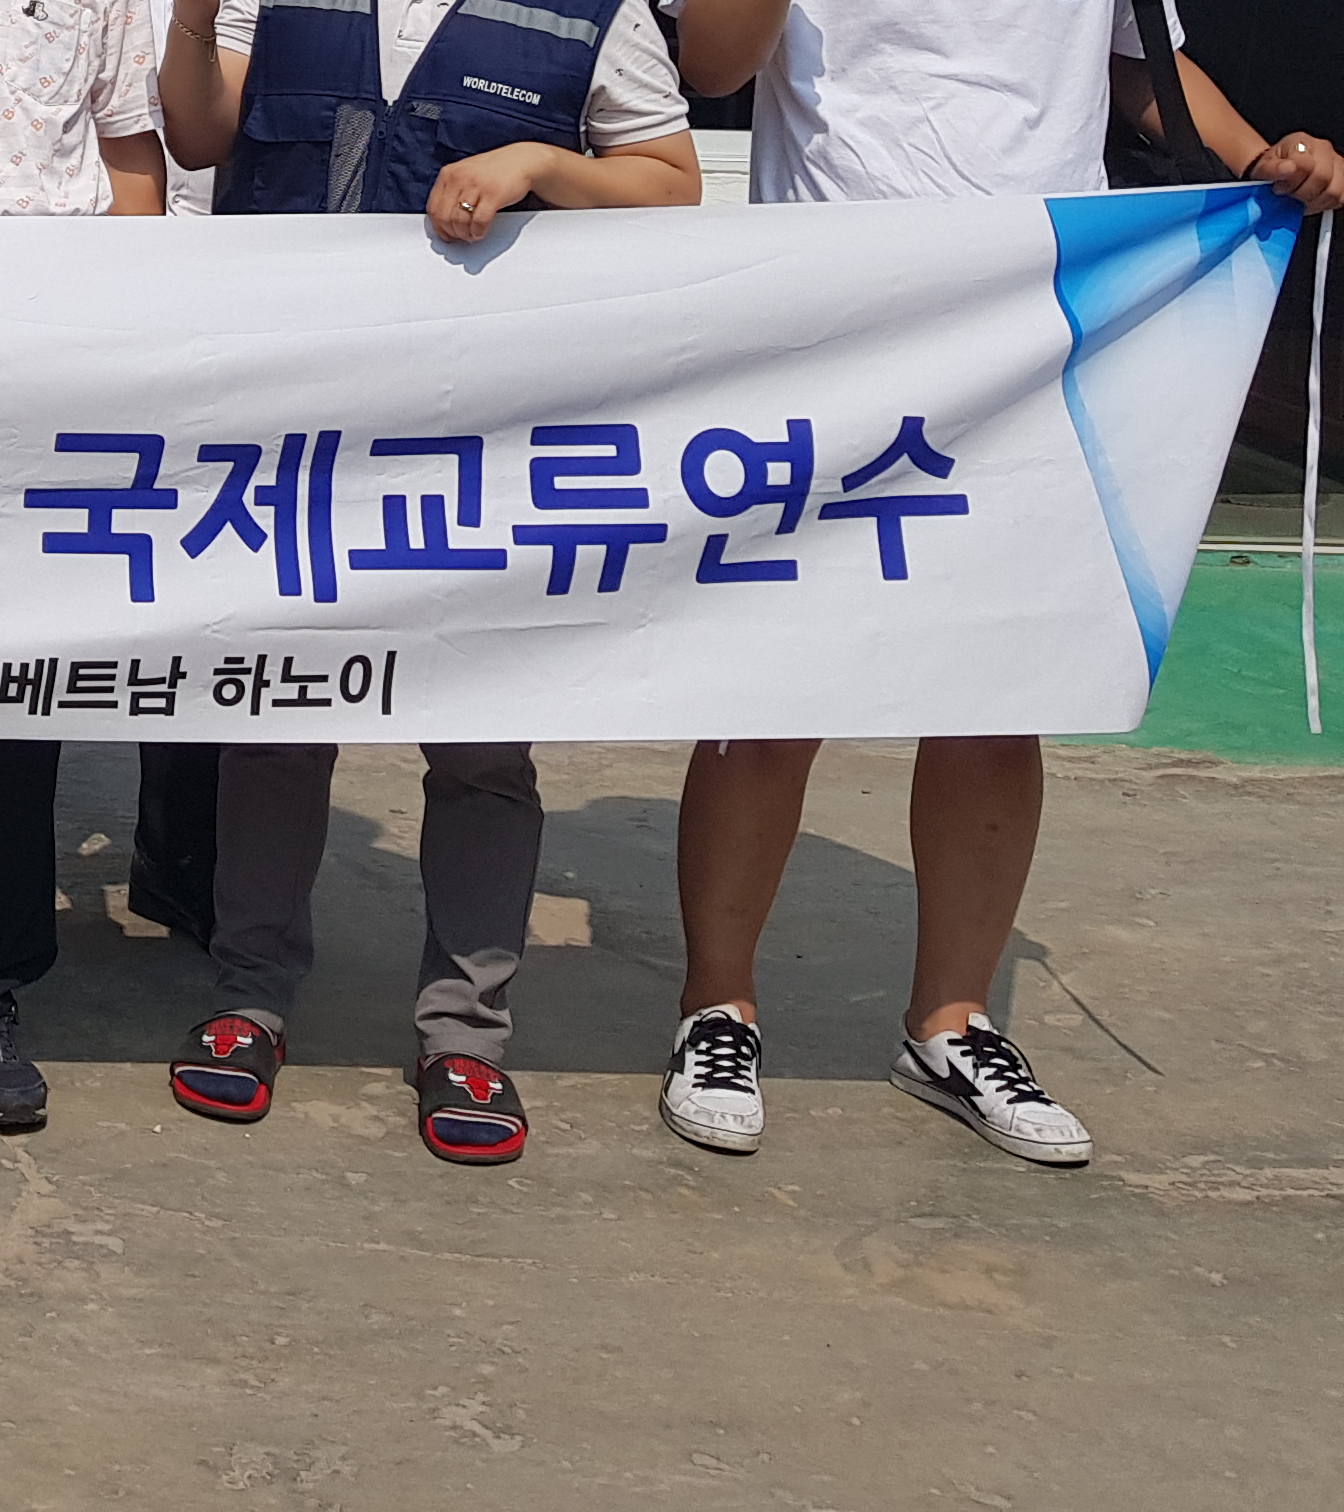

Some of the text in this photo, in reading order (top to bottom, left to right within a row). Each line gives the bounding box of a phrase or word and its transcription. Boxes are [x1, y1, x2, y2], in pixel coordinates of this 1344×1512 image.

[462, 75, 542, 106] WORLDTELECOM
[25, 417, 969, 603] 국제교류연수
[212, 650, 399, 717] 하노이
